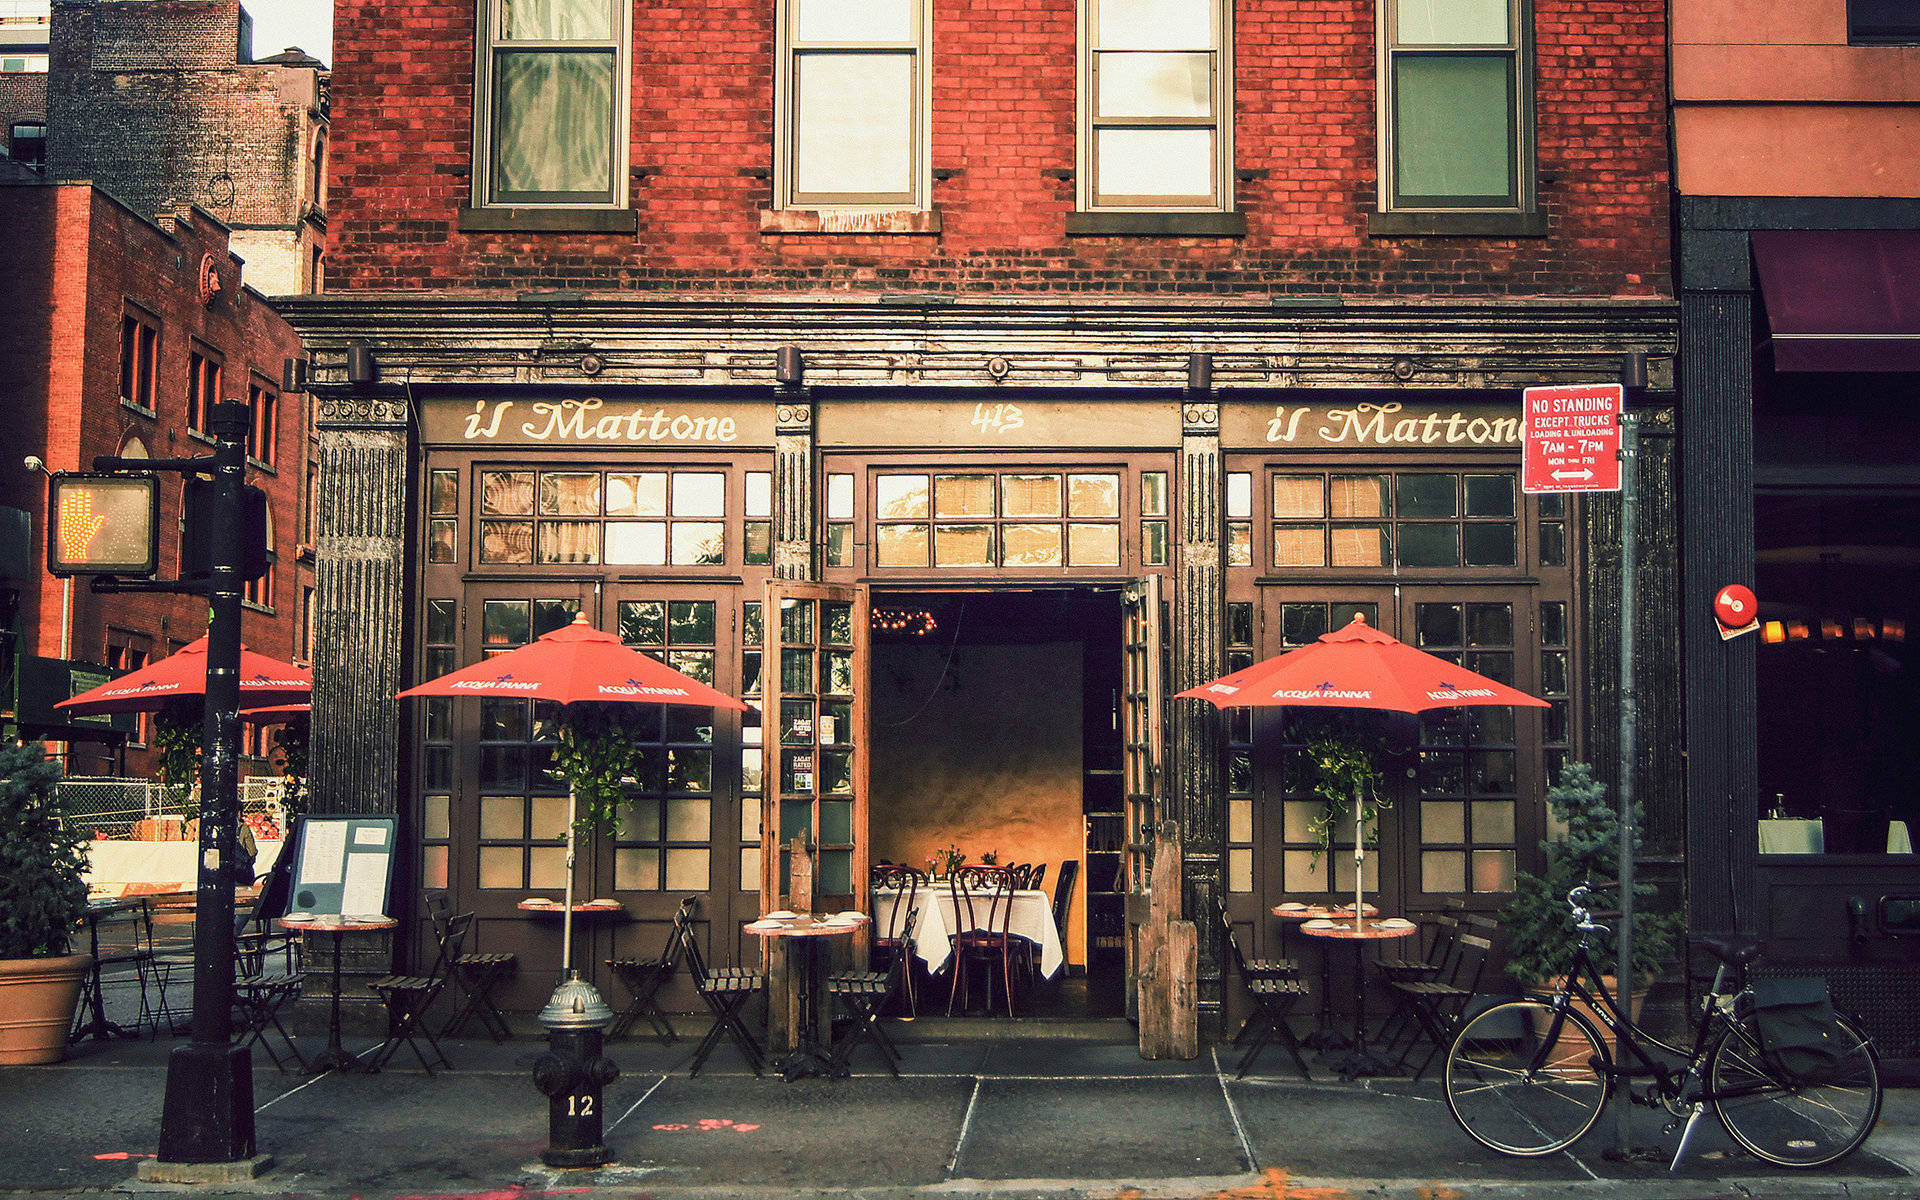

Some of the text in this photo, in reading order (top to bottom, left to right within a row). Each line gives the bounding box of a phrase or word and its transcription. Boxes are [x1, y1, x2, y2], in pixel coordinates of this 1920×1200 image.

[1532, 397, 1613, 413] NO STANDING
[521, 397, 738, 442] Mattone
[971, 403, 1024, 433] 413
[1535, 415, 1610, 428] EXCEPT TRUCKS
[1530, 430, 1562, 438] LOADING
[1571, 428, 1614, 437] UNLOADING
[1540, 440, 1565, 455] 7AM
[1577, 439, 1604, 454] 7PM
[1547, 457, 1565, 465] MON
[1582, 456, 1595, 464] FRI
[450, 681, 496, 690] ACQUA
[598, 685, 690, 697] ACQUA PANNA
[1272, 690, 1371, 699] ACQUA PANNA
[568, 1095, 593, 1117] 12
